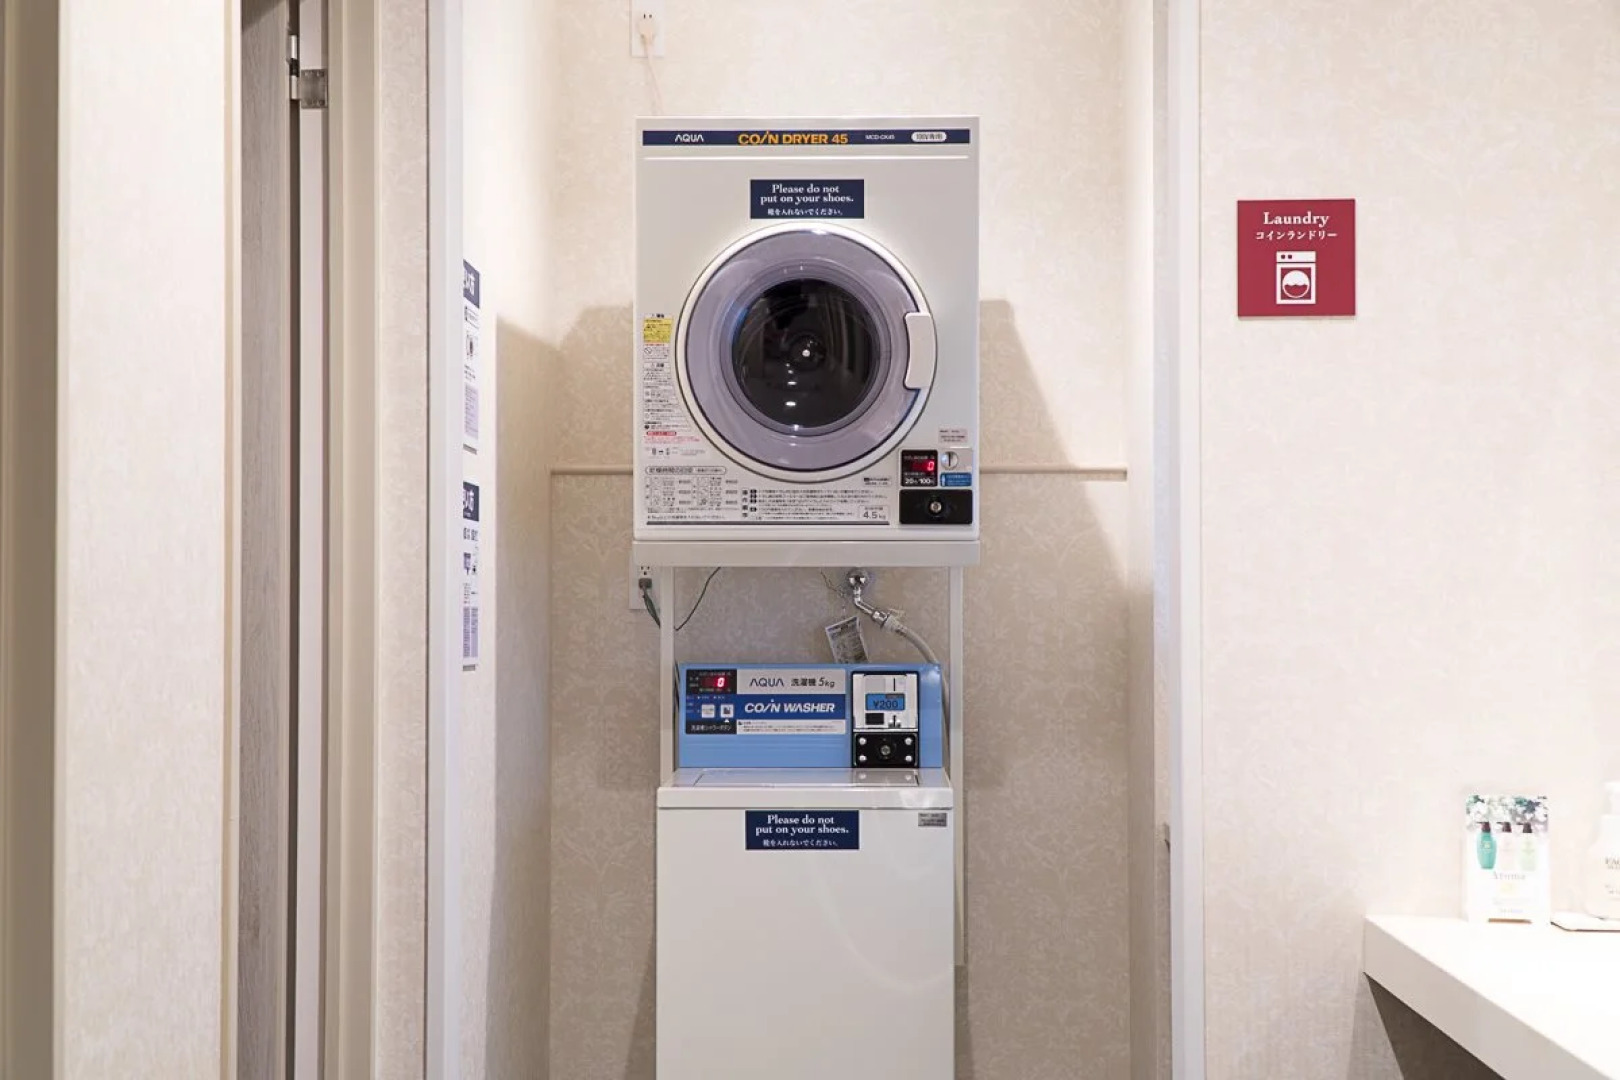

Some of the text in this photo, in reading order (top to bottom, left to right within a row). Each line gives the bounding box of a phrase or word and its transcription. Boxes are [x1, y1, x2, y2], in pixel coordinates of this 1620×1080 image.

[674, 133, 704, 143] AQUA
[782, 133, 828, 144] DRYER
[831, 133, 848, 144] 45
[772, 183, 839, 194] Please do not
[760, 195, 778, 206] put
[795, 196, 820, 206] your
[823, 193, 854, 202] shoes.
[1263, 210, 1330, 228] Laundry
[1255, 230, 1338, 241] コインランドリー
[927, 461, 935, 471] 0
[717, 677, 725, 688] 0
[749, 677, 784, 688] AQUA
[783, 702, 835, 713] WASHER
[767, 814, 834, 824] Please do not
[755, 826, 773, 836] put
[790, 827, 815, 837] your
[818, 824, 849, 834] shoes.
